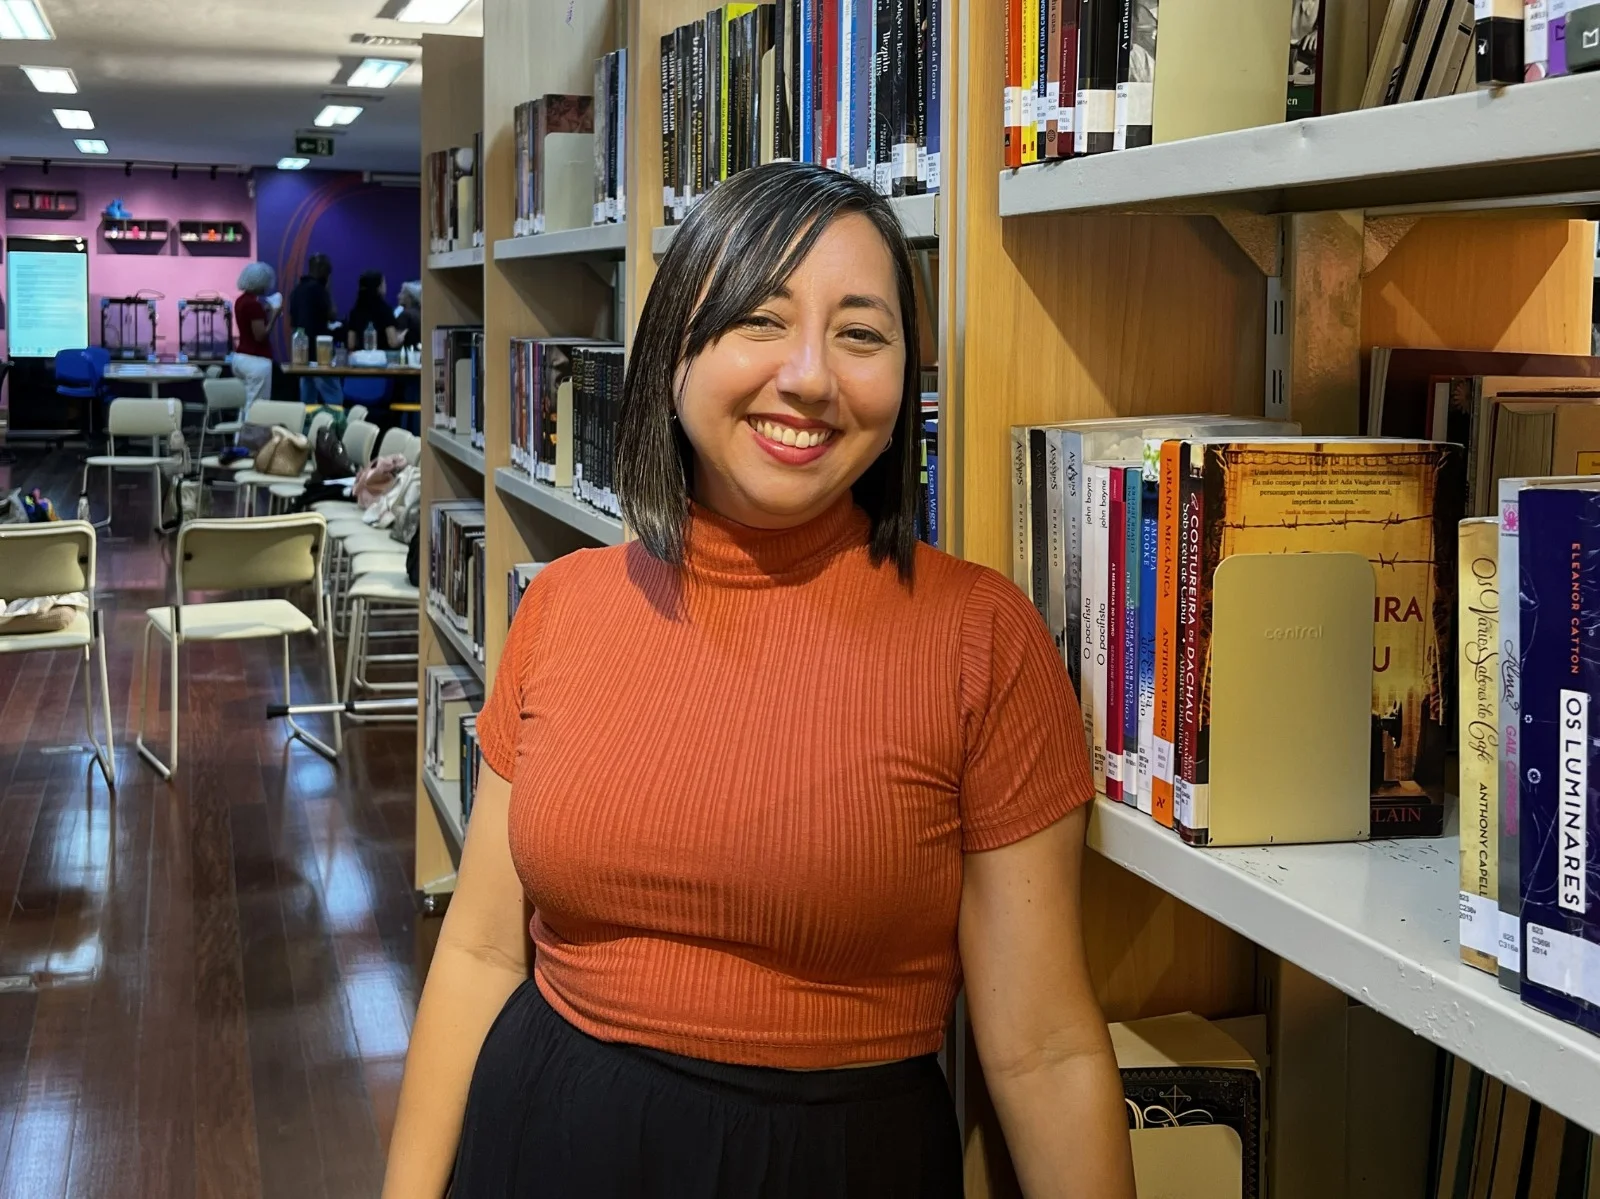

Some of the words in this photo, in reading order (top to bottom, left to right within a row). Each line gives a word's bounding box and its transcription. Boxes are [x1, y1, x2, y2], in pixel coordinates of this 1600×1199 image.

[932, 50, 938, 61] da
[918, 100, 924, 112] do
[1100, 480, 1108, 507] boyne
[928, 498, 936, 530] Wiggs
[1100, 508, 1108, 528] john
[1182, 532, 1188, 540] o
[1164, 525, 1172, 598] MECÂNICA
[1181, 568, 1188, 583] de
[1188, 514, 1198, 625] COSTUREIRA
[1472, 558, 1497, 586] Os
[1570, 542, 1580, 610] ELEANOR
[1083, 598, 1093, 644] pacifista
[1097, 602, 1107, 650] pacifista
[1188, 630, 1194, 642] DE
[1264, 625, 1324, 640] central
[1468, 589, 1498, 652] Vários
[1084, 648, 1090, 660] O
[1096, 654, 1105, 666] O
[1570, 618, 1580, 674] CATTON
[1140, 658, 1149, 716] Coração
[1186, 646, 1195, 724] DACHAU
[1465, 642, 1498, 702] Sabores
[1478, 703, 1494, 718] do
[1566, 698, 1582, 730] OS
[1468, 721, 1498, 764] Café
[1506, 726, 1517, 757] GAIL
[1479, 782, 1488, 848] ANTHONY
[1564, 740, 1582, 906] LUMINARES
[1478, 850, 1488, 897] CAPELL
[1532, 926, 1544, 935] 823
[1532, 946, 1548, 956] 2014
